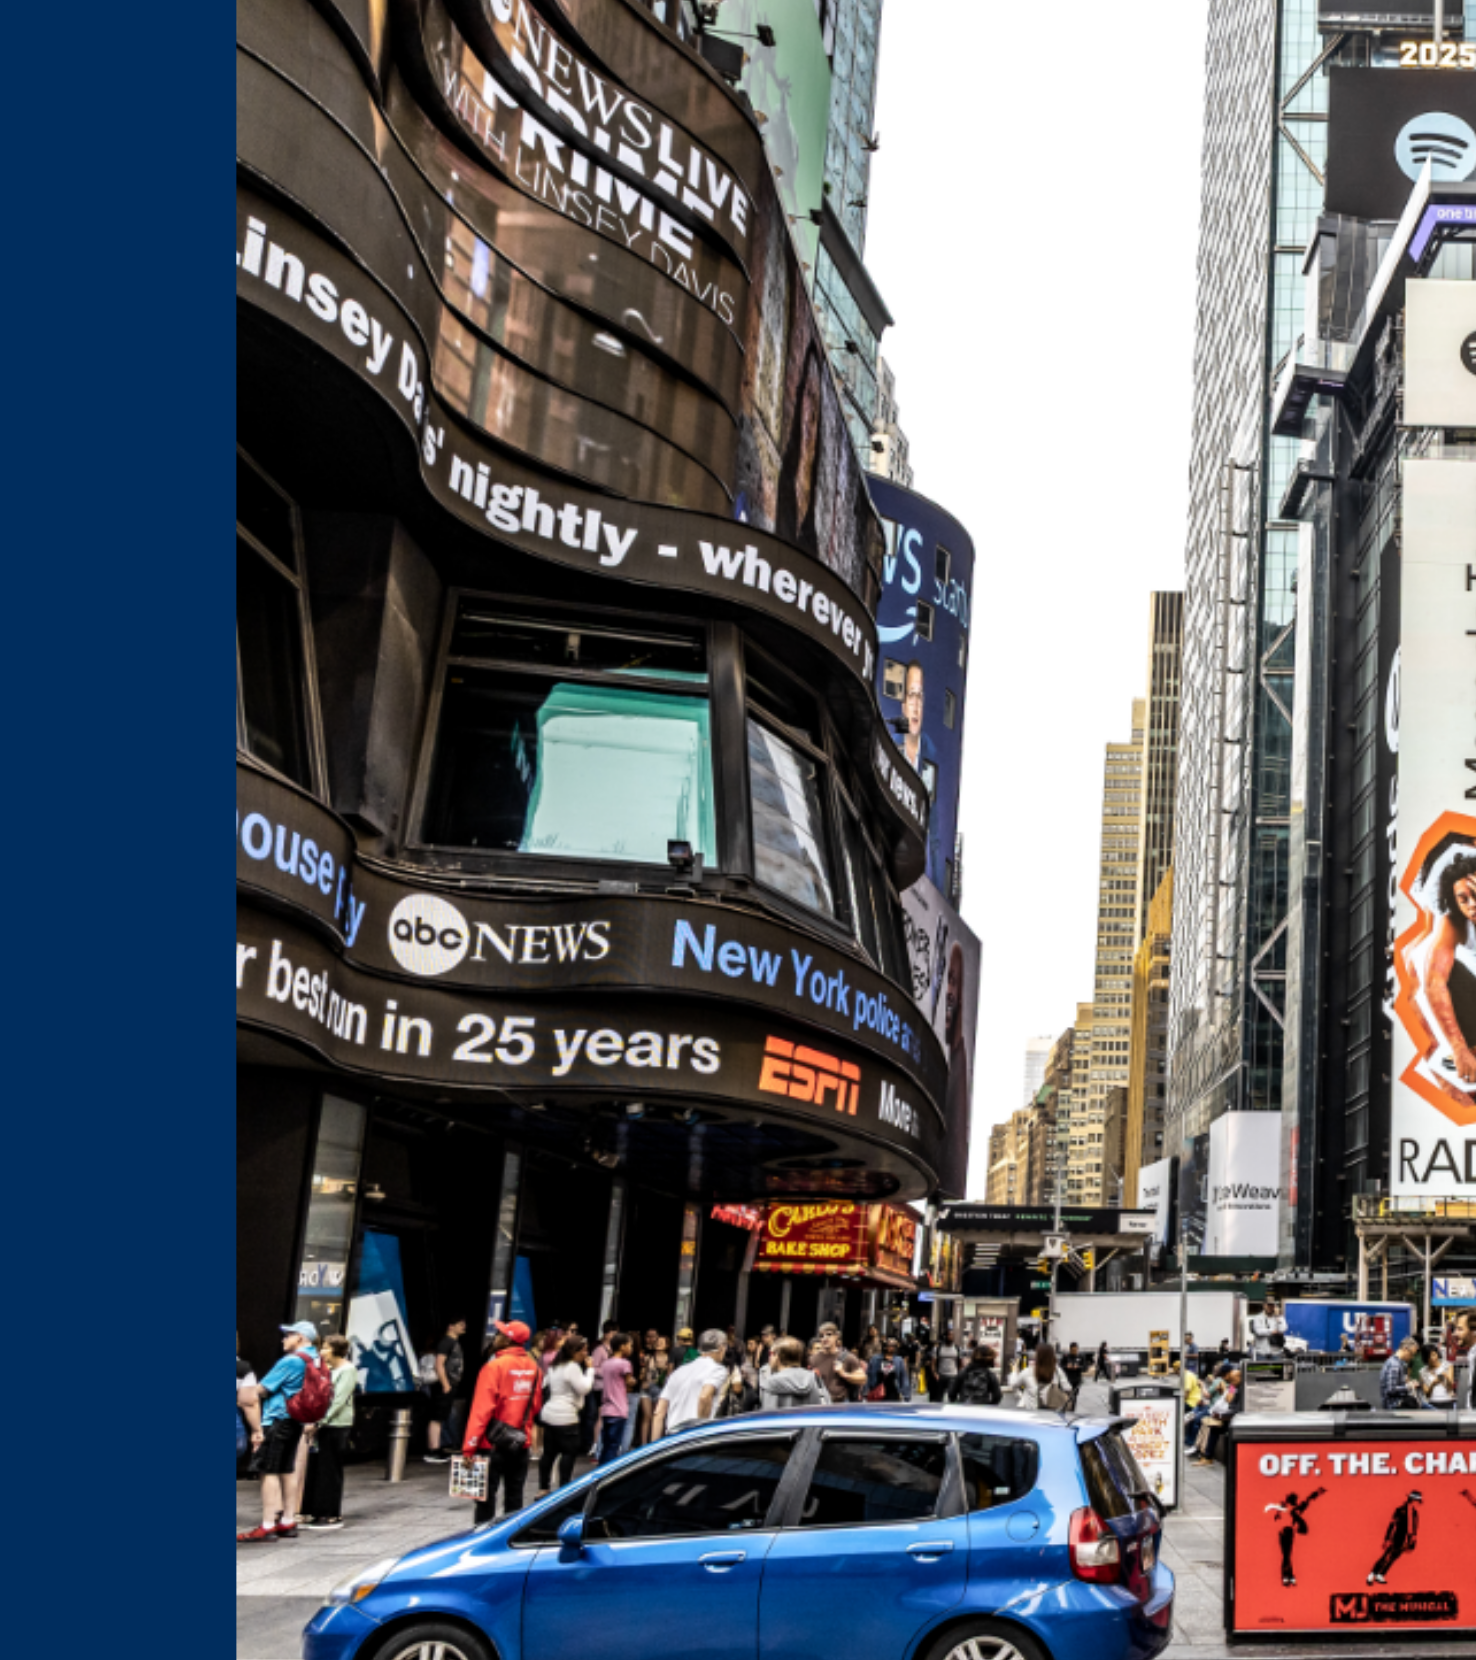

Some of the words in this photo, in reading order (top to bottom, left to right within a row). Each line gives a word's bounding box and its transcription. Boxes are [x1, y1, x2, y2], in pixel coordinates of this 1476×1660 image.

[511, 0, 653, 149] NEWS
[658, 123, 747, 238] LIVE
[514, 146, 642, 248] LINSEY
[650, 241, 734, 325] DAVIS
[1437, 208, 1463, 219] one
[236, 215, 393, 375] insey
[449, 454, 638, 567] nightly
[698, 541, 863, 656] wherever
[236, 808, 335, 895] ouse
[266, 939, 329, 1024] best
[327, 988, 368, 1045] run
[380, 998, 434, 1057] in
[452, 1013, 535, 1065] 25
[551, 1027, 721, 1077] years
[393, 916, 463, 950] abc
[469, 920, 611, 964] NEWS
[671, 918, 783, 988] New
[790, 946, 851, 1017] York
[853, 988, 901, 1045] police
[757, 1034, 861, 1116] ESPN
[766, 1241, 806, 1257] BAKE
[809, 1242, 851, 1259] SHOP
[1259, 1453, 1321, 1477] OFF.
[1328, 1452, 1399, 1475] THE.
[1335, 1596, 1368, 1620] MJ
[1373, 1601, 1396, 1613] THE
